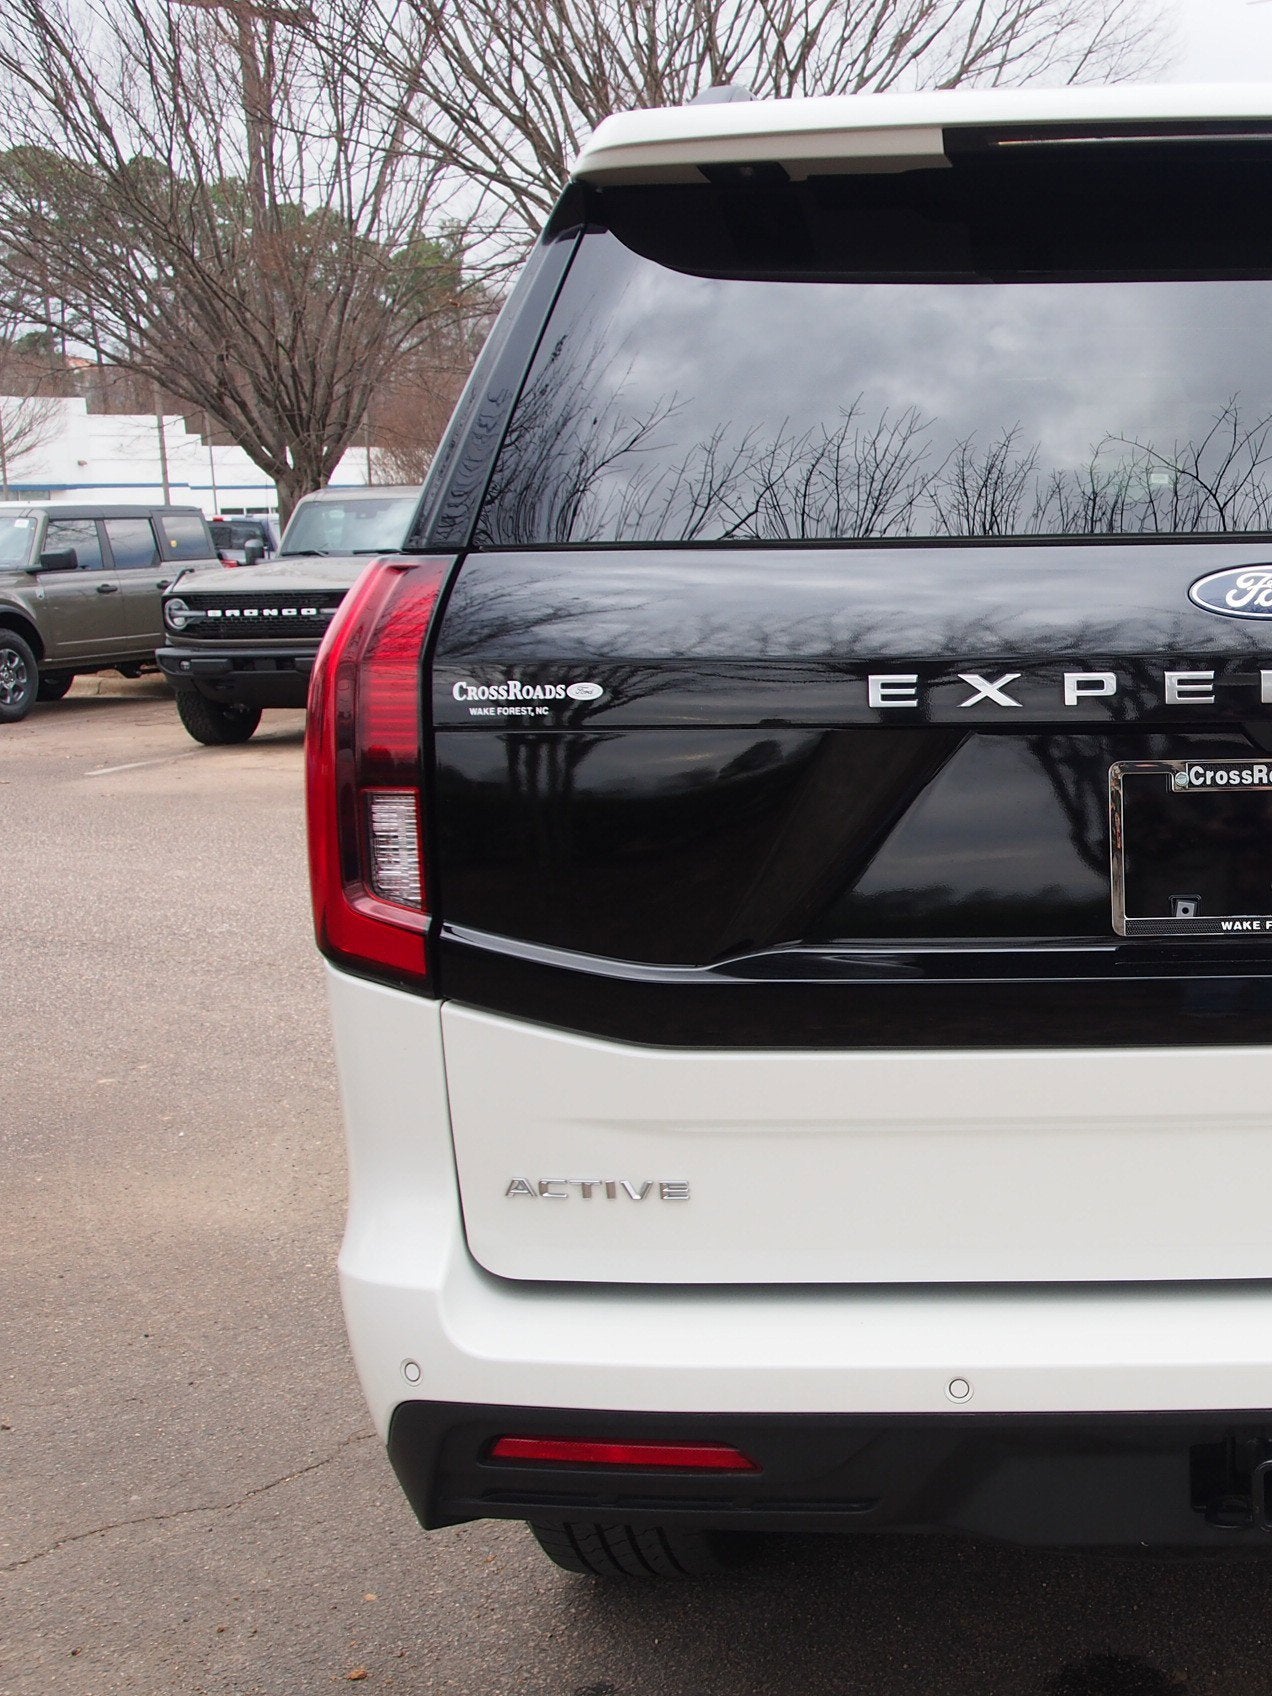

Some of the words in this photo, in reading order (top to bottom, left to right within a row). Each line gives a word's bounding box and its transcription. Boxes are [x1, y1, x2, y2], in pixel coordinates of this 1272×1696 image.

[207, 608, 318, 617] BRONCO
[469, 707, 496, 716] WAKE
[498, 707, 535, 716] FOREST,
[536, 707, 549, 715] NC
[1221, 920, 1261, 930] WAKE
[504, 1177, 691, 1201] ACTIVE
